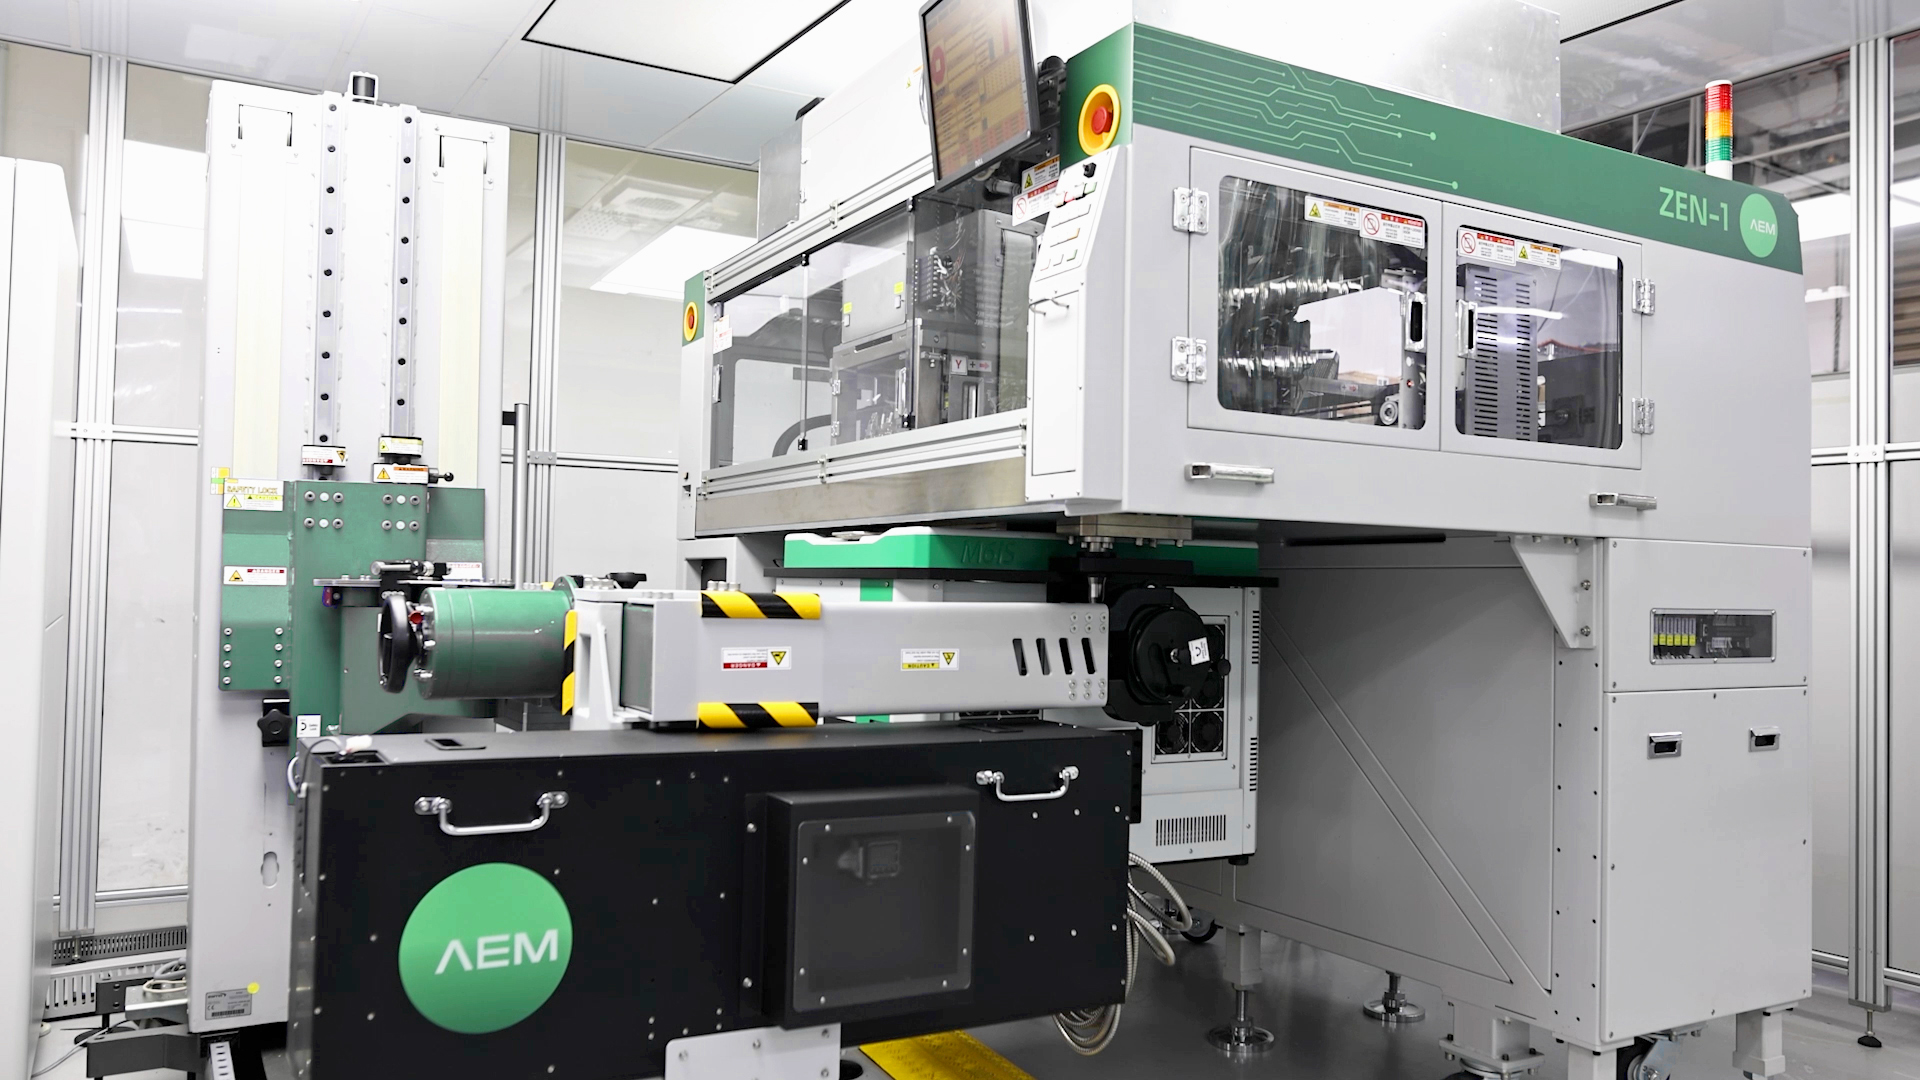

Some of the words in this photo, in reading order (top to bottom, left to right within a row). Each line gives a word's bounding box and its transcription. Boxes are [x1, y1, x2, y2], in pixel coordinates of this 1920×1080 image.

[1659, 186, 1728, 231] ZEN-1
[1750, 219, 1776, 236] AEM
[955, 359, 962, 369] Y
[226, 485, 256, 494] SAFETY
[258, 486, 278, 495] LOCK
[434, 928, 559, 975] AEM
